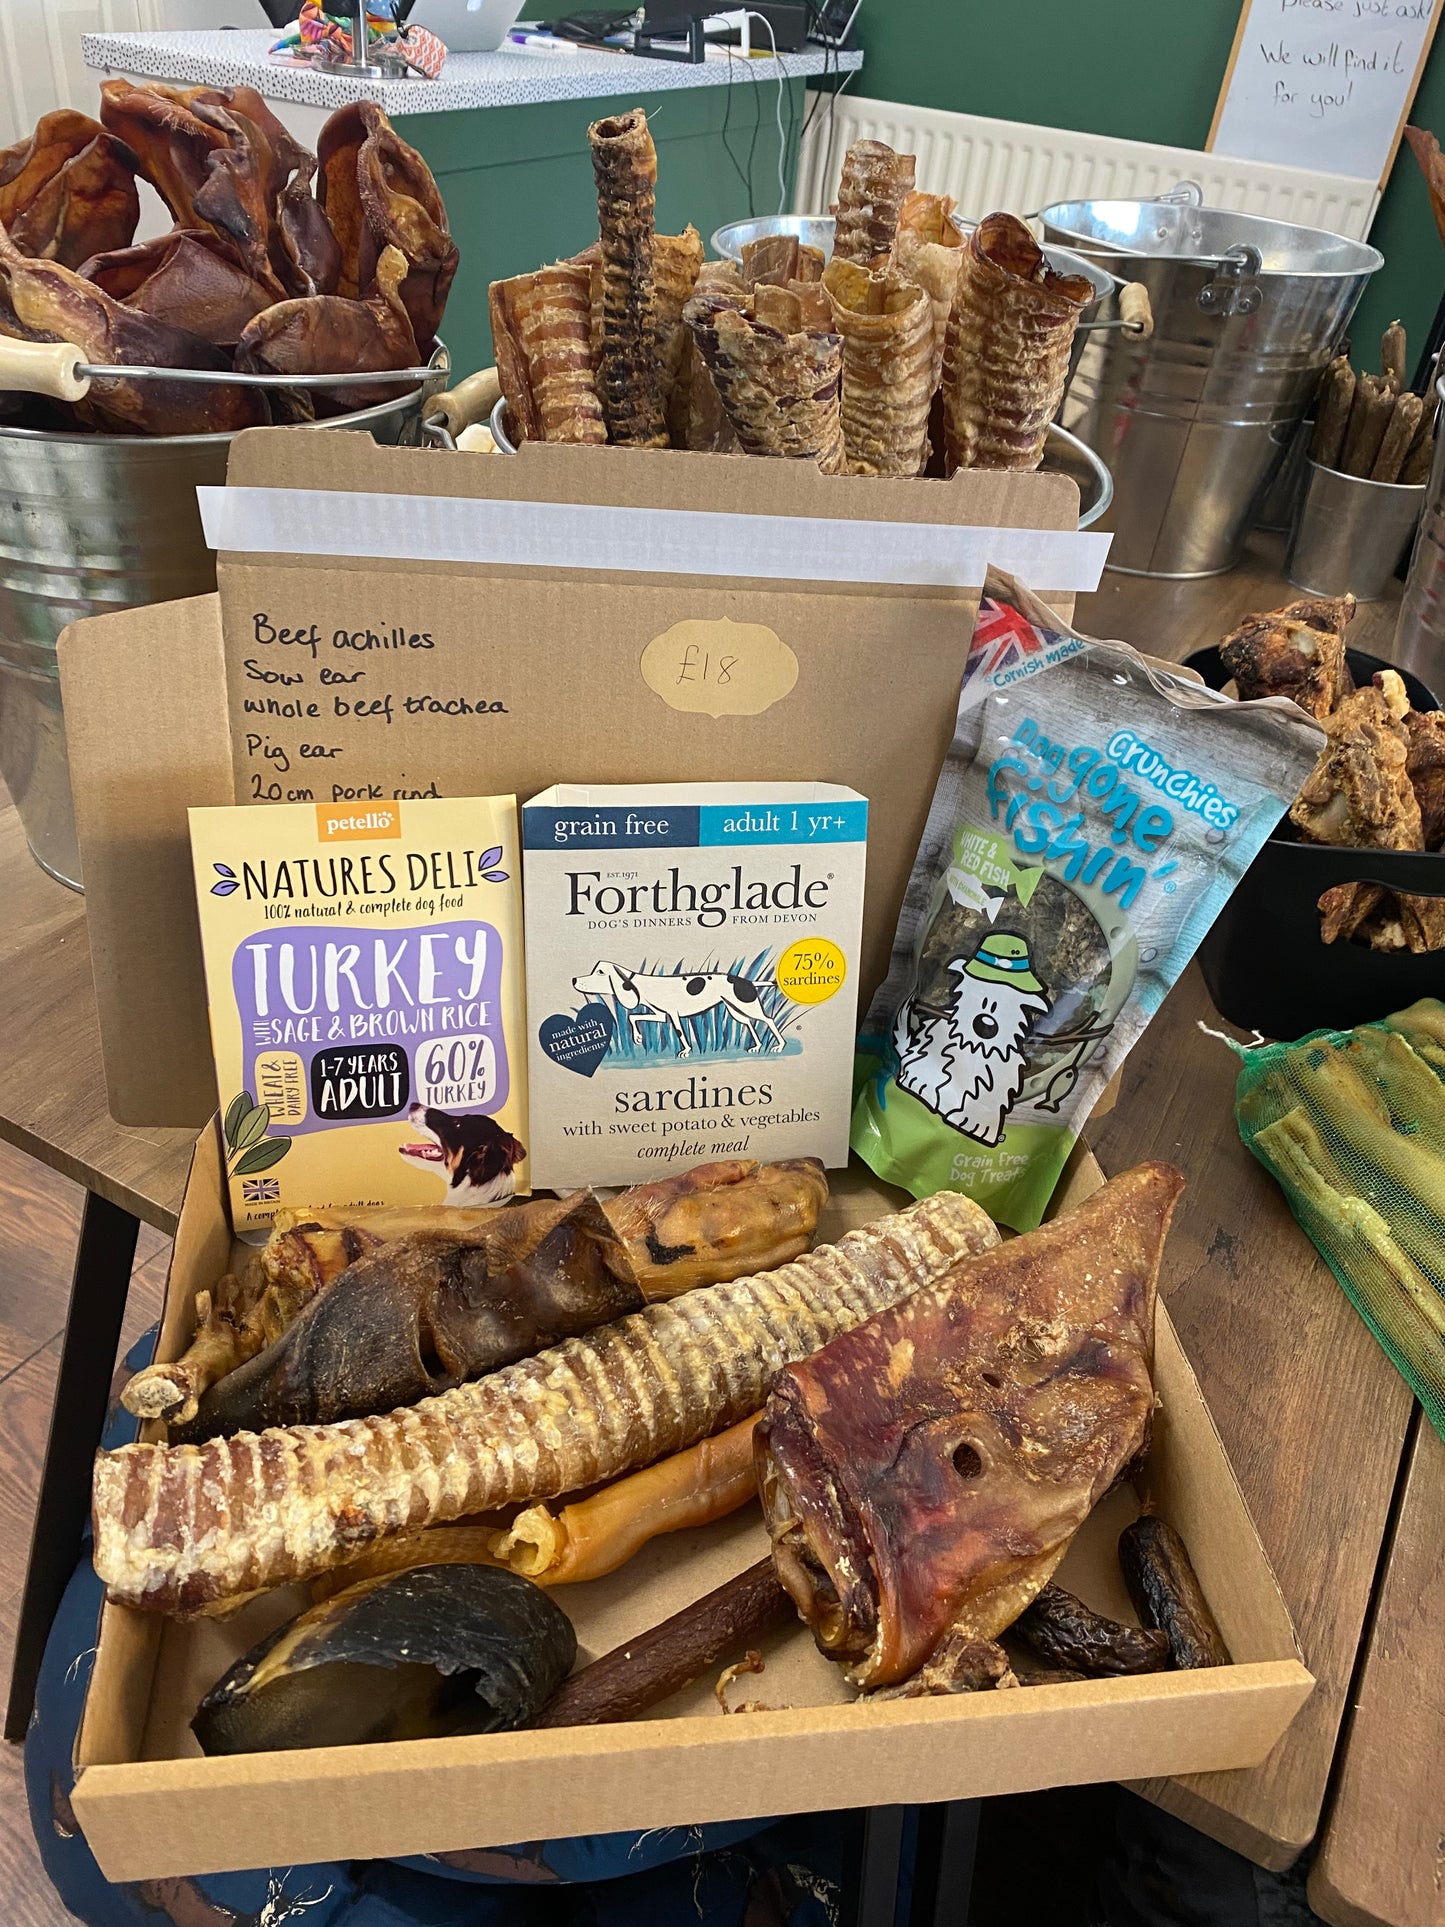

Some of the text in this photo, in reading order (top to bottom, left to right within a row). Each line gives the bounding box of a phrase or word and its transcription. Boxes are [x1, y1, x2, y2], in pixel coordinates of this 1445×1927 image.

[1260, 40, 1404, 78] We will find it
[1273, 81, 1353, 118] for you!
[253, 613, 435, 658] Beef achilles
[244, 659, 366, 685] Sow ear
[676, 644, 739, 685] £18
[993, 658, 1045, 687] Cornish
[244, 694, 510, 724] whole beef trachea
[246, 733, 344, 772] Pig ear
[332, 783, 384, 802] pork
[327, 812, 391, 835] petello
[554, 812, 669, 843] grain free
[723, 810, 846, 837] adult 1 yr+
[987, 842, 998, 859] &
[242, 850, 479, 900] NATURES DELI
[622, 871, 638, 880] 1971
[960, 850, 1011, 886] RED FISH
[264, 893, 464, 920] 100% natural & complete dog food
[564, 864, 829, 929] Forthglade
[588, 913, 817, 930] DOG'S DINNERS FROM DEVON
[245, 929, 487, 1016] TURKEY
[793, 951, 834, 973] 75%
[783, 972, 840, 987] sardines
[271, 1001, 492, 1045] SAGE & BROWN RICE
[548, 1022, 608, 1053] natural
[551, 1019, 598, 1040] made with
[320, 1051, 399, 1078] 1-7 YEARS
[424, 1039, 486, 1086] 60%
[261, 1060, 285, 1117] WHEAT &
[283, 1060, 301, 1116] DAIRY FREE
[320, 1072, 402, 1112] ADULT
[425, 1081, 486, 1106] TURKEY
[614, 1076, 773, 1114] sardines
[563, 1108, 821, 1137] with sweet potato & vegetables
[637, 1135, 750, 1163] complete meal
[953, 1151, 1029, 1169] Grain Free
[950, 1166, 1026, 1187] Dog Treats
